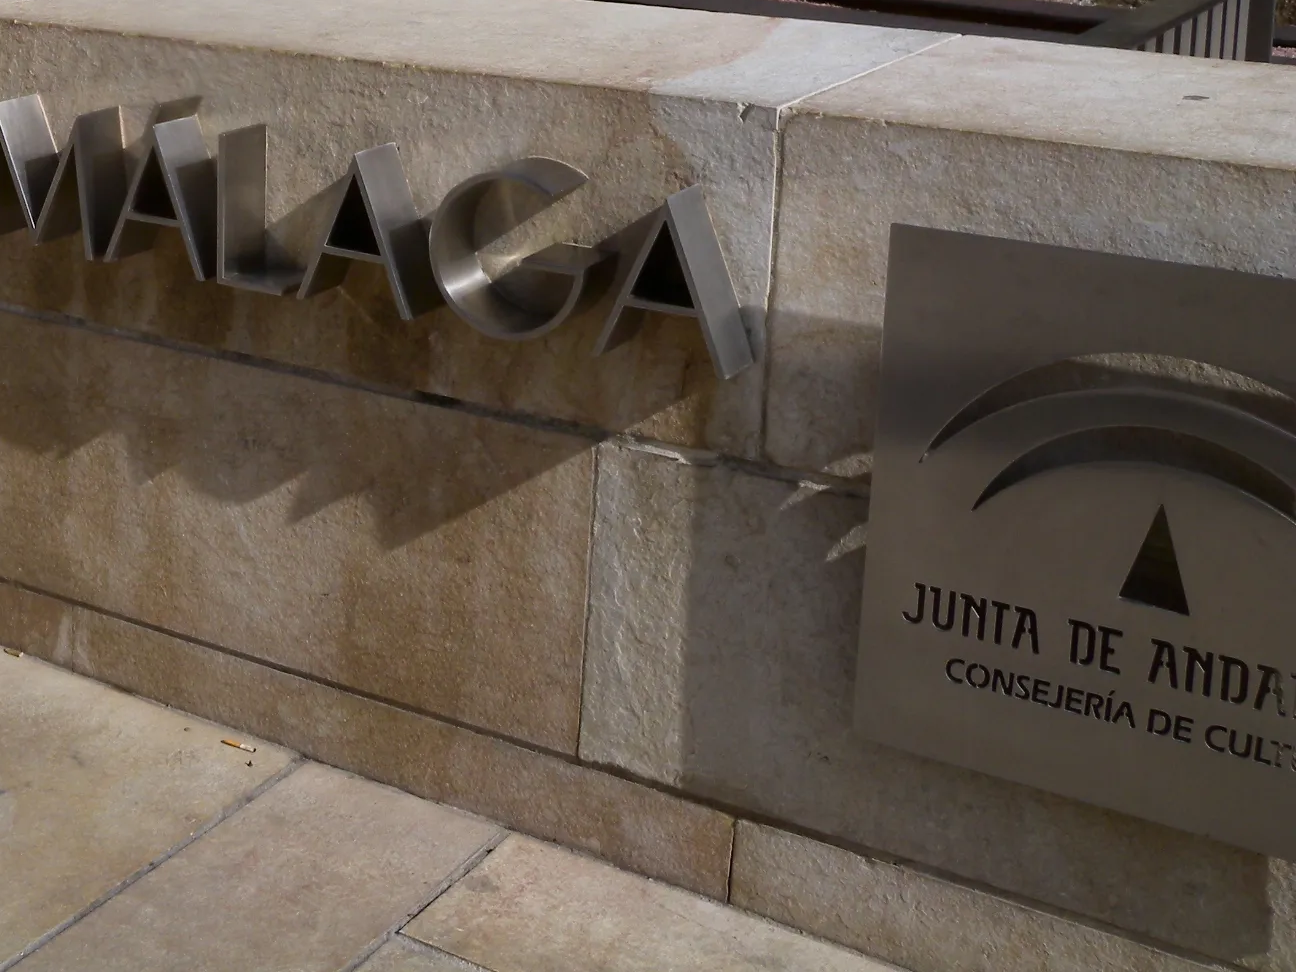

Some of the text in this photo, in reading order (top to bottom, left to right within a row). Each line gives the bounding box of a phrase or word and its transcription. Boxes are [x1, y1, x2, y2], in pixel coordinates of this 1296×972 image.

[902, 582, 1041, 655] JUNTA
[1068, 617, 1124, 675] DE
[944, 657, 1136, 729] CONSEJERÍA
[1146, 708, 1195, 745] DE
